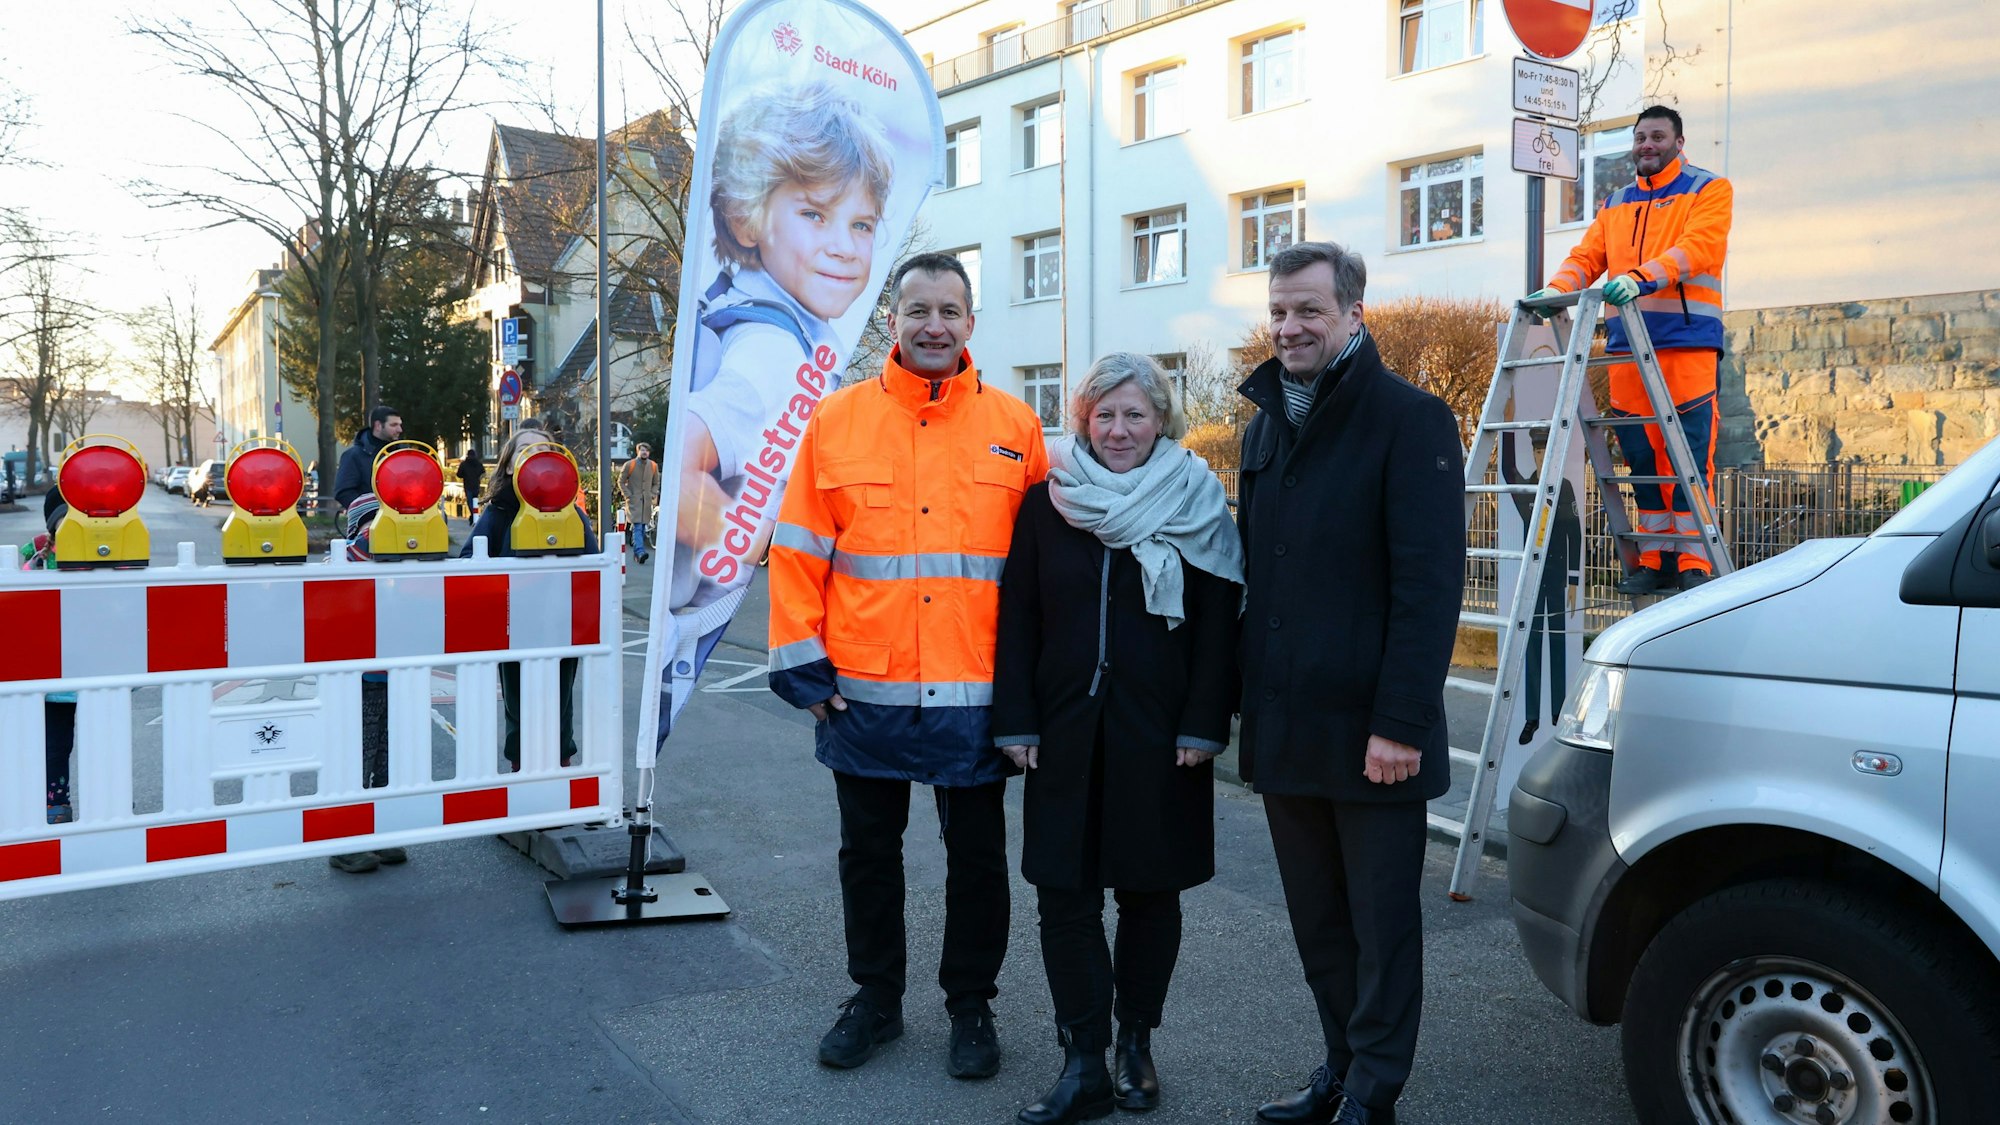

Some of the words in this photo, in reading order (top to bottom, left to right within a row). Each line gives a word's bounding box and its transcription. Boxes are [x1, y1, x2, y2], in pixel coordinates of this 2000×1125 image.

[813, 45, 858, 77] Stadt
[862, 64, 897, 92] Köln
[1518, 69, 1537, 81] Mo-Fr
[1539, 73, 1568, 87] 7:45-8:30
[1569, 80, 1574, 88] h
[1540, 87, 1554, 96] und
[1523, 95, 1561, 110] 14:45-15:15
[1562, 102, 1567, 110] h
[1539, 157, 1554, 171] frei
[505, 322, 514, 342] P
[700, 344, 837, 585] Schulstraße
